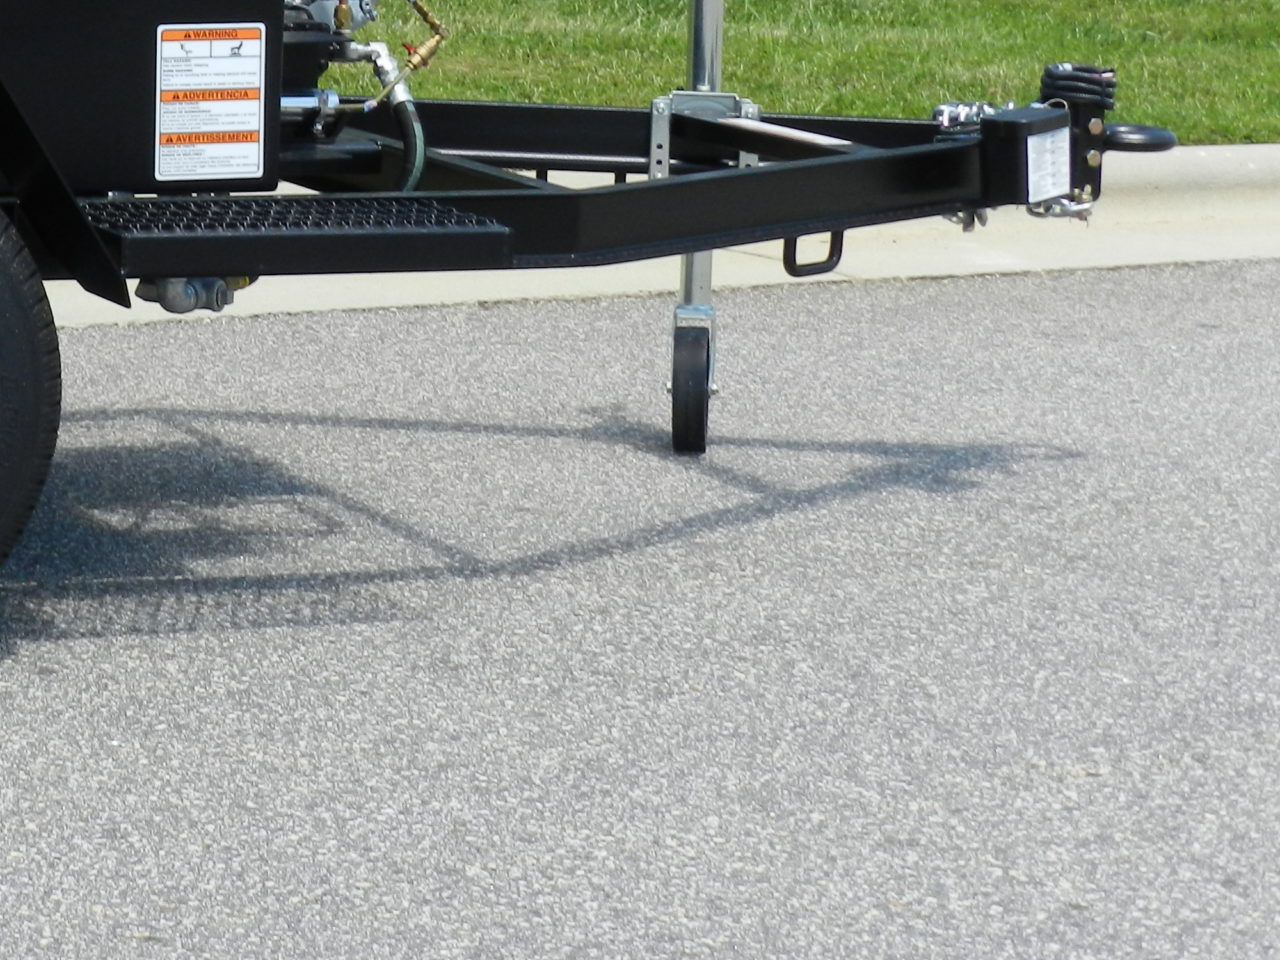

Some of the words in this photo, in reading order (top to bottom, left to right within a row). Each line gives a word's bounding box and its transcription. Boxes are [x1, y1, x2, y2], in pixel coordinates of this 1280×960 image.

[193, 30, 238, 39] WARNING
[182, 91, 249, 101] ADVERTENCIA
[175, 133, 254, 144] AVERTISSEMENT
